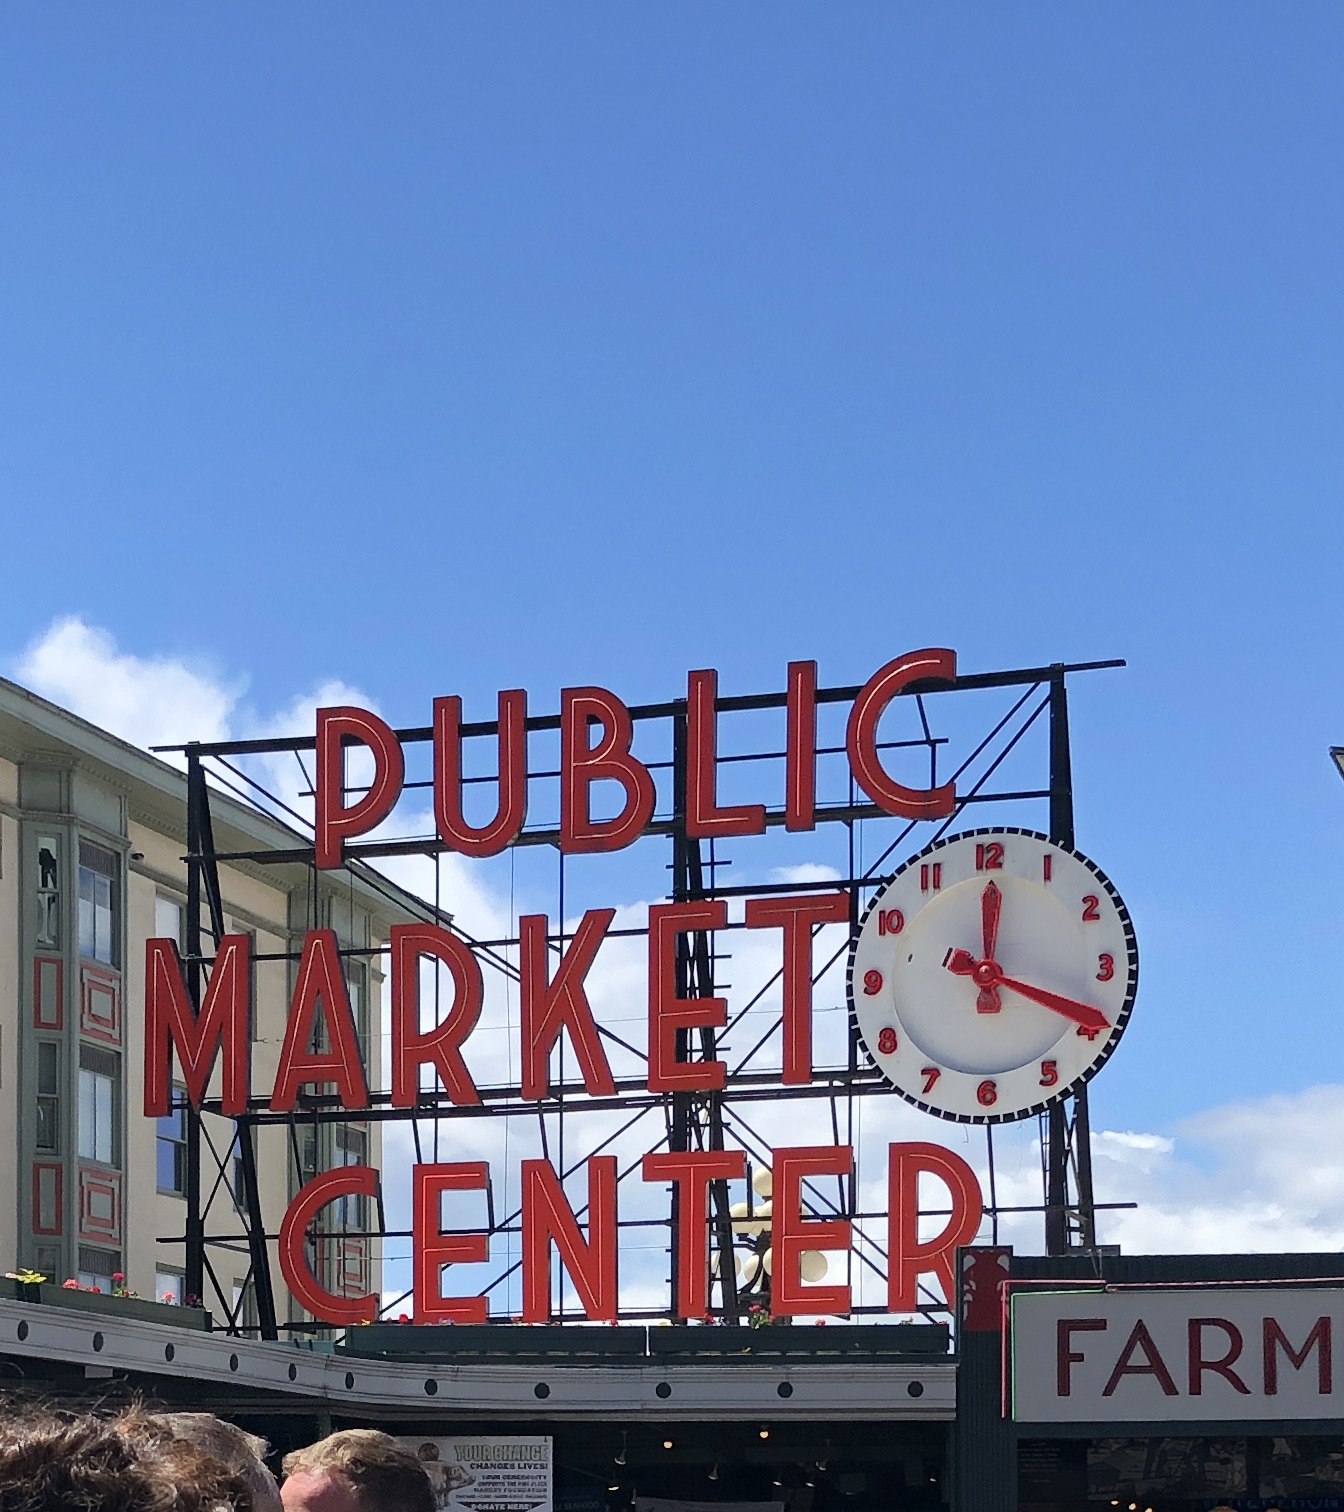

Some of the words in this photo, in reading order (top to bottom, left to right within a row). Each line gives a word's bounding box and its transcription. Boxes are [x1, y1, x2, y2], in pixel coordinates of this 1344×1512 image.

[314, 648, 957, 869] PUBLIC
[975, 843, 1004, 871] 12
[1043, 854, 1052, 883] 1
[921, 863, 941, 892] 11
[1082, 895, 1100, 921] 2
[878, 909, 905, 936] 10
[1096, 953, 1114, 981] 3
[863, 970, 883, 996] 9
[144, 893, 851, 1118] MARKET
[878, 1027, 898, 1054] 8
[921, 1067, 941, 1094] 7
[1039, 1060, 1058, 1086] 5
[976, 1080, 997, 1106] 6
[278, 1141, 984, 1326] CENTER
[454, 1444, 491, 1461] YOUR
[492, 1444, 548, 1461] CHANGE
[470, 1462, 515, 1470] CHANGES
[471, 1503, 506, 1511] DONATE
